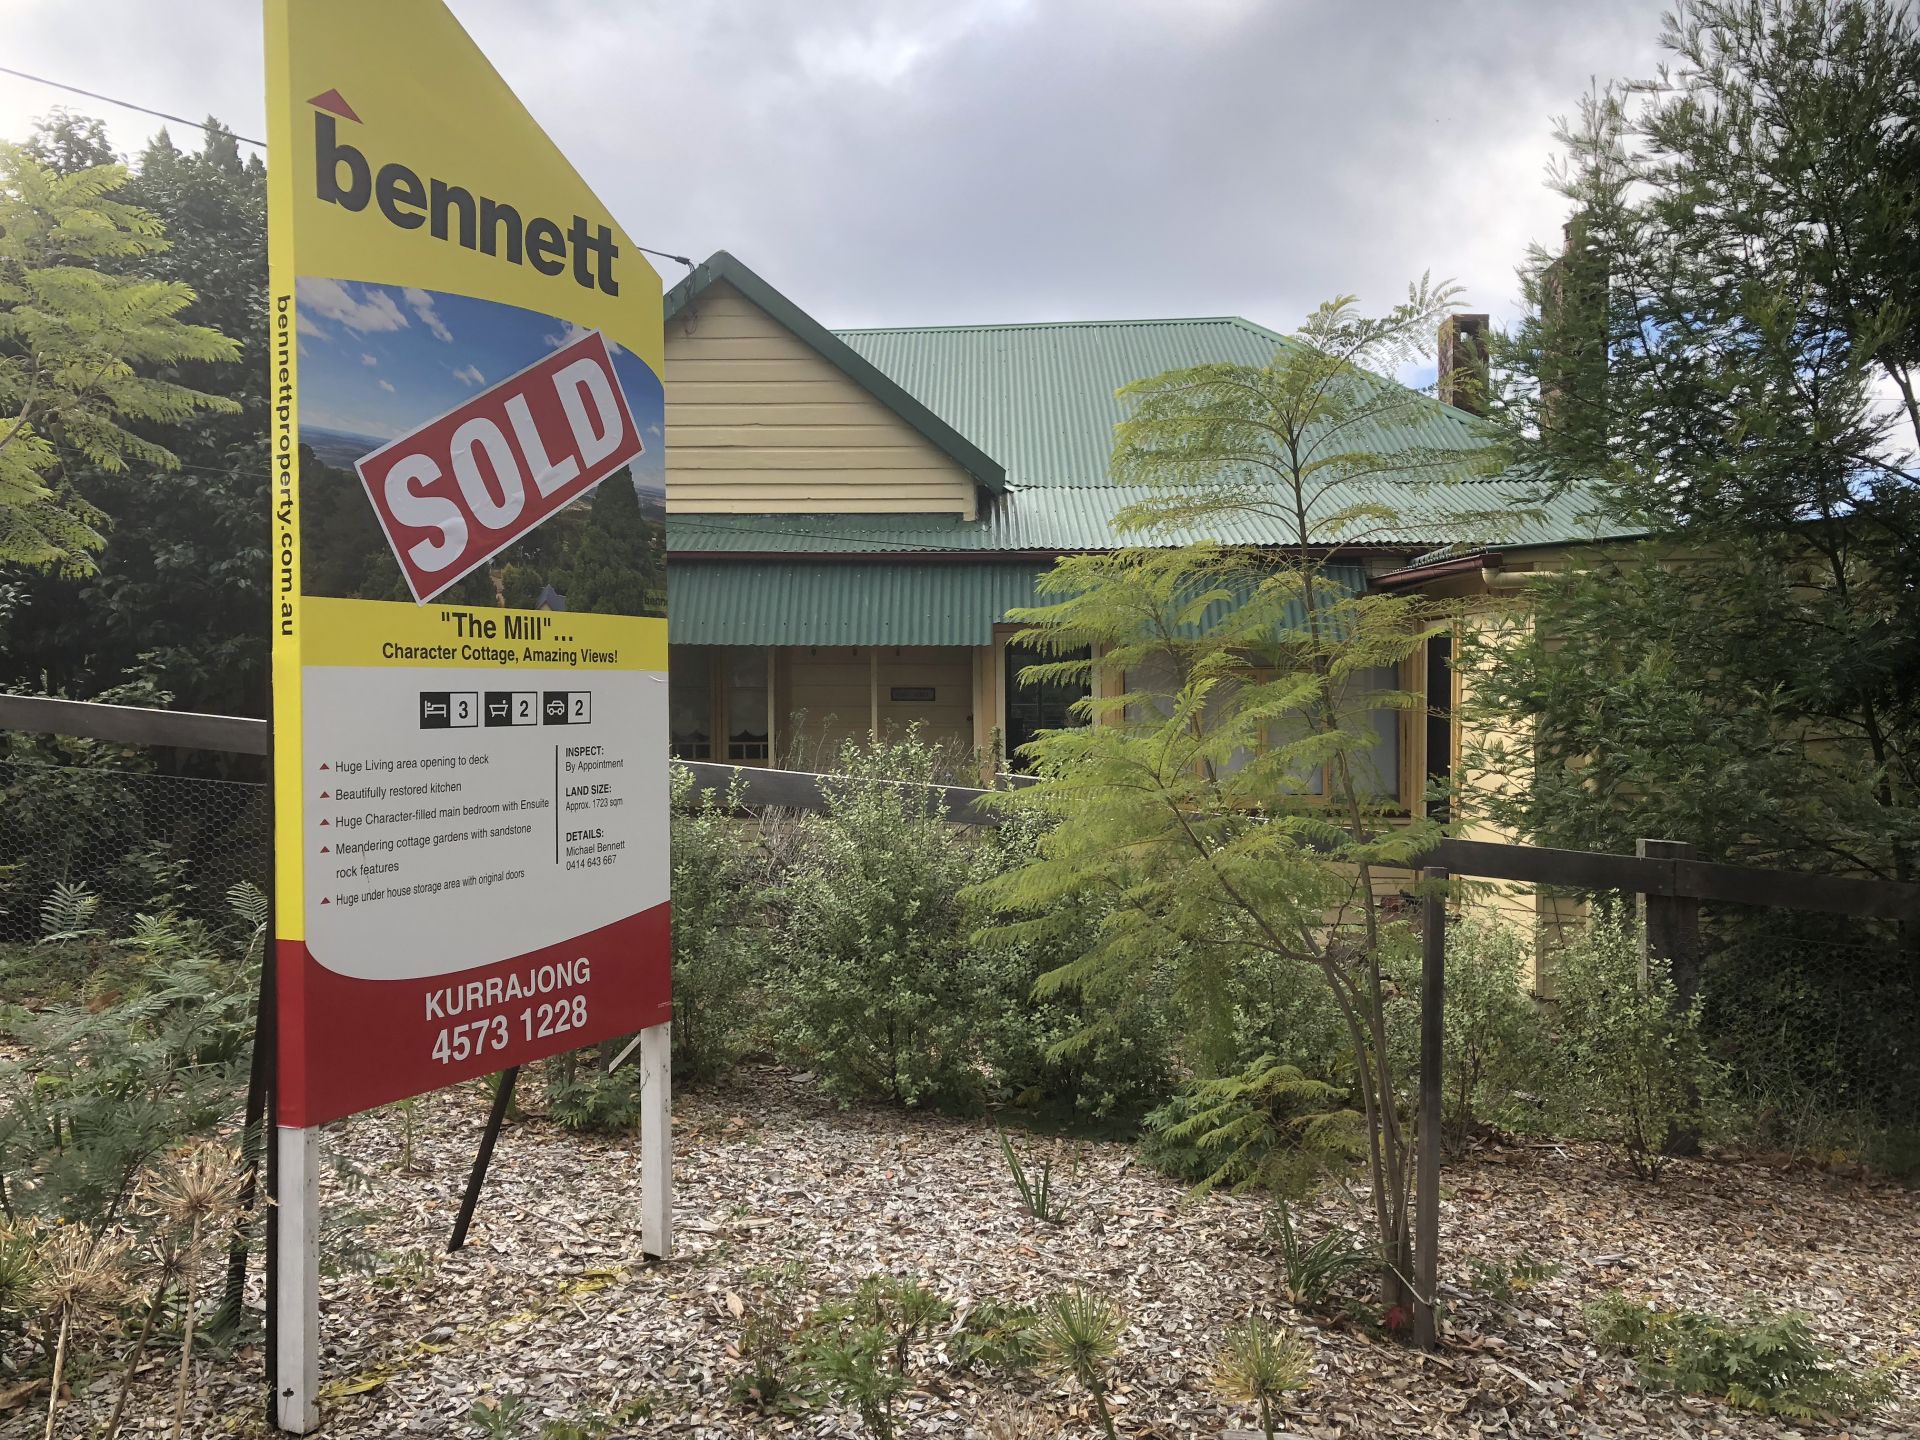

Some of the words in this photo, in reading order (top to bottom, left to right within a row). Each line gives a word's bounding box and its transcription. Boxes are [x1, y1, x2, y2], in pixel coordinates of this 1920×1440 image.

[314, 110, 620, 297] bennett
[275, 295, 294, 636] bennettproperty.com.au
[384, 358, 624, 573] SOLD
[441, 611, 497, 639] "The
[382, 642, 457, 660] Character
[461, 644, 519, 665] Cottage,
[522, 646, 577, 666] Amazing
[580, 648, 618, 663] Views!
[458, 700, 469, 719] 3
[519, 700, 529, 717] 2
[575, 699, 584, 716] 2
[565, 746, 604, 757] INSPECT:
[335, 760, 363, 774] Huge
[364, 758, 394, 773] Living
[396, 759, 418, 769] area
[420, 756, 456, 770] opening
[457, 755, 467, 766] to
[468, 754, 489, 765] deck
[565, 761, 576, 773] By
[577, 759, 624, 772] Appointment
[335, 786, 387, 800] Beautifully
[389, 783, 428, 796] restored
[430, 781, 462, 793] kitchen
[565, 785, 589, 797] LAND
[591, 783, 612, 795] SIZE:
[335, 815, 363, 829] Huge
[365, 808, 437, 825] Character-filled
[439, 807, 461, 818] main
[462, 803, 500, 816] bedroom
[501, 800, 519, 811] with
[520, 798, 549, 810] Ensuite
[565, 800, 591, 812] Approx.
[592, 798, 609, 809] 1723
[609, 798, 623, 808] sqm
[335, 839, 394, 855] Meandering
[396, 834, 431, 849] cottage
[433, 830, 469, 846] gardens
[470, 827, 488, 839] with
[489, 823, 532, 837] sandstone
[565, 828, 604, 842] DETAILS:
[566, 844, 596, 857] Michael
[597, 840, 626, 853] Bennett
[335, 866, 358, 879] rock
[359, 860, 400, 876] features
[566, 860, 586, 871] 0414
[586, 856, 602, 868] 643
[602, 853, 617, 866] 667
[335, 893, 360, 907] Huge
[361, 887, 385, 902] under
[386, 882, 412, 898] house
[413, 879, 443, 895] storage
[444, 877, 461, 891] area
[462, 873, 478, 887] with
[478, 869, 504, 886] original
[505, 869, 525, 880] doors
[425, 957, 591, 1021] KURRAJONG
[431, 1015, 509, 1065] 4573
[520, 995, 587, 1041] 1228
